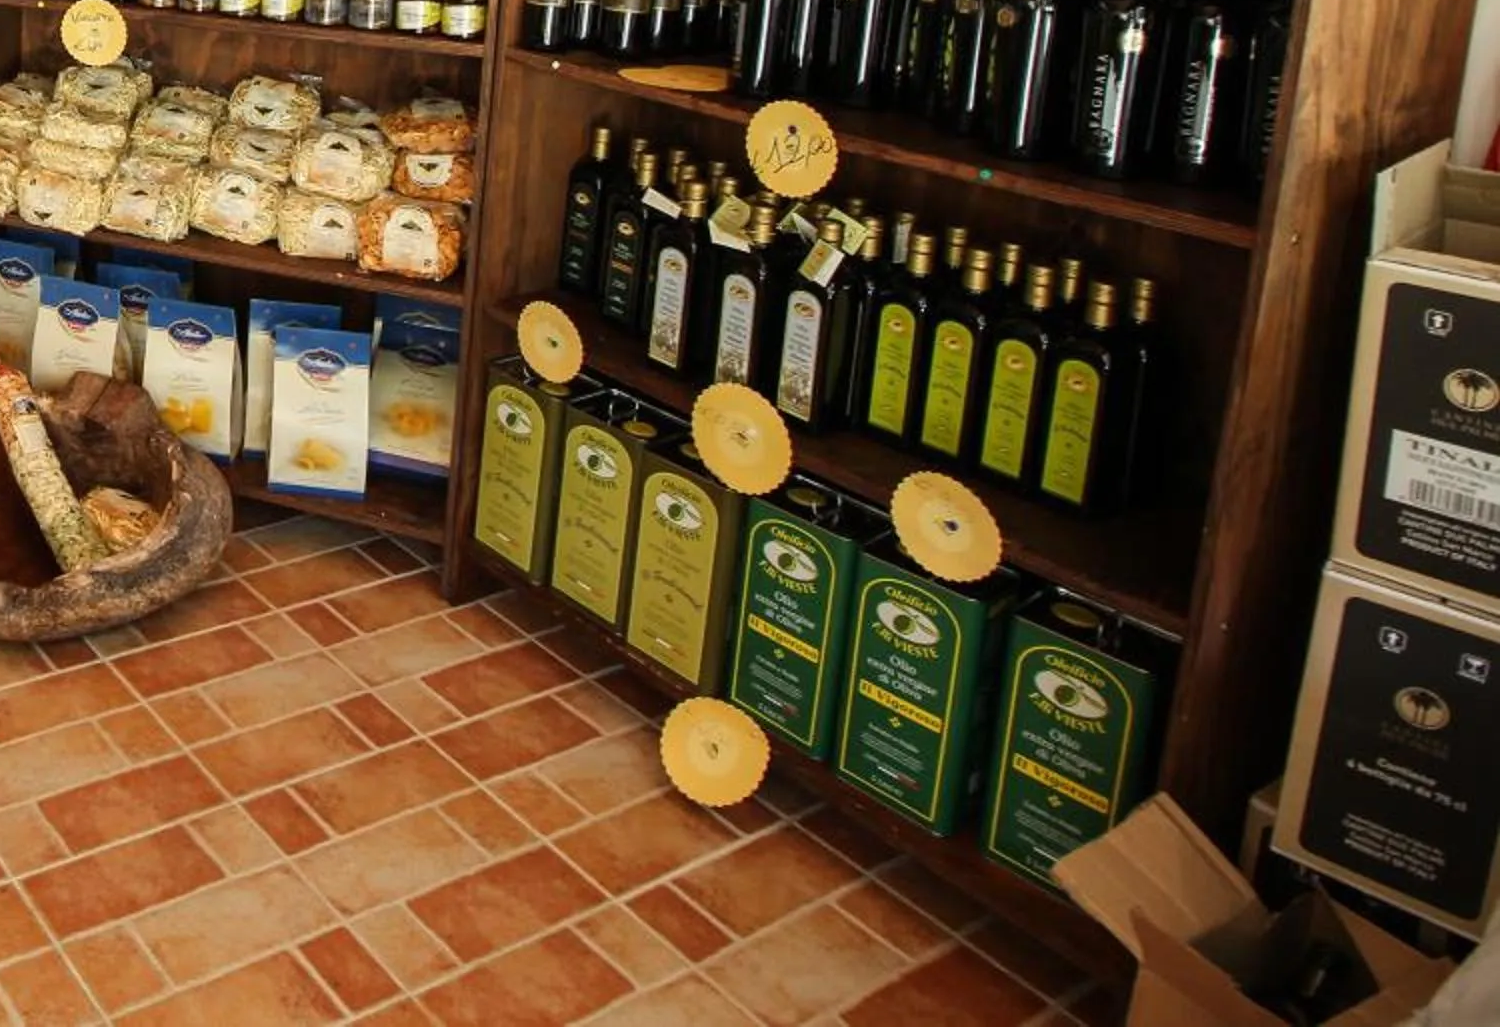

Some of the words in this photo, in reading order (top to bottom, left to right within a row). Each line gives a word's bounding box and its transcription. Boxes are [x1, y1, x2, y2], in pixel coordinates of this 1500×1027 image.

[1404, 436, 1500, 472] TINAI
[771, 526, 816, 554] Oleificio
[1401, 536, 1450, 557] PRODUCT
[1466, 555, 1497, 571] ITALY
[773, 589, 799, 610] Olio
[777, 574, 818, 595] VIESTE
[884, 585, 938, 617] Oleificio
[763, 622, 818, 660] Vigoroso
[893, 637, 940, 660] VIESTE
[889, 653, 918, 676] Olio
[1043, 654, 1106, 688] Oleificio
[877, 689, 942, 729] Vigoroso
[1054, 708, 1106, 734] VIESTE
[1048, 728, 1082, 752] Olio
[1034, 764, 1108, 812] Vigoroso
